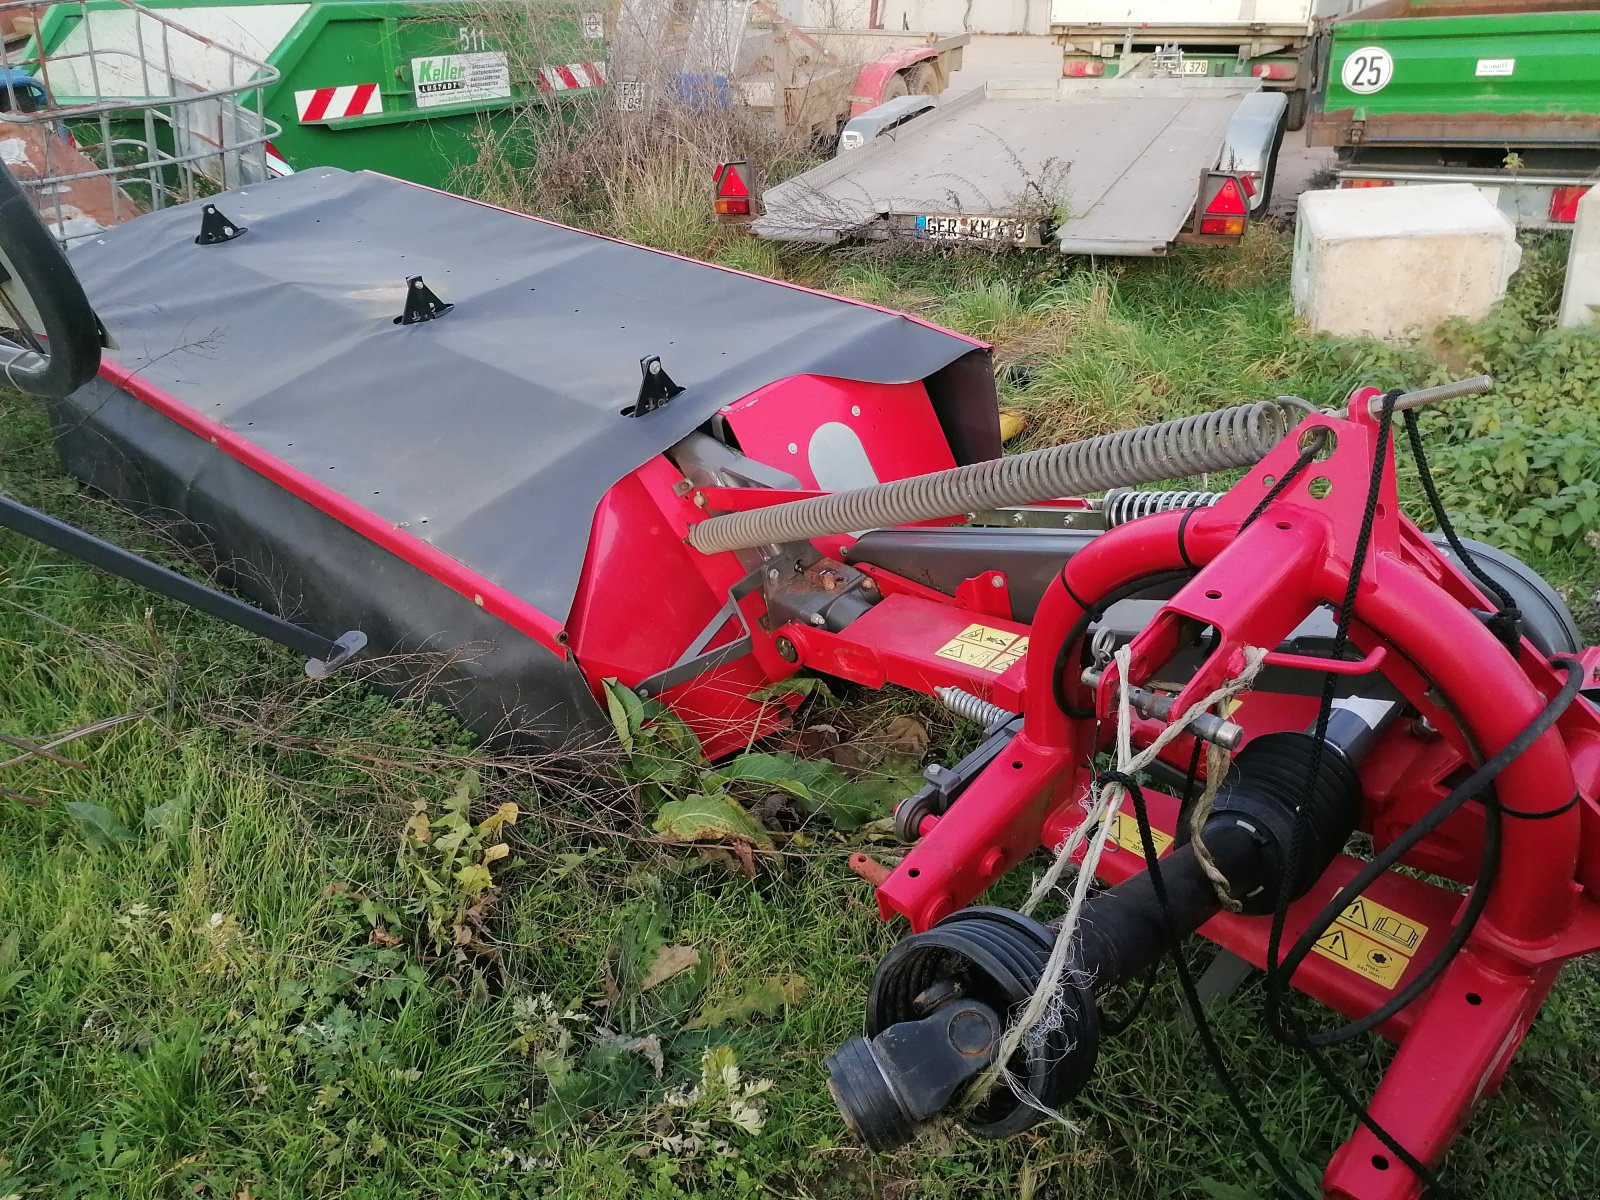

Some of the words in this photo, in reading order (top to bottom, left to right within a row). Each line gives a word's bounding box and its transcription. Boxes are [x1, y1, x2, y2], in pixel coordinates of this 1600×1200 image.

[459, 27, 485, 51] 511
[419, 57, 466, 83] Keller
[1189, 62, 1206, 73] 378
[1351, 56, 1383, 86] 25
[421, 82, 458, 93] LUSTADT
[927, 218, 957, 237] GER
[969, 219, 991, 238] KM
[1357, 964, 1368, 972] 540
